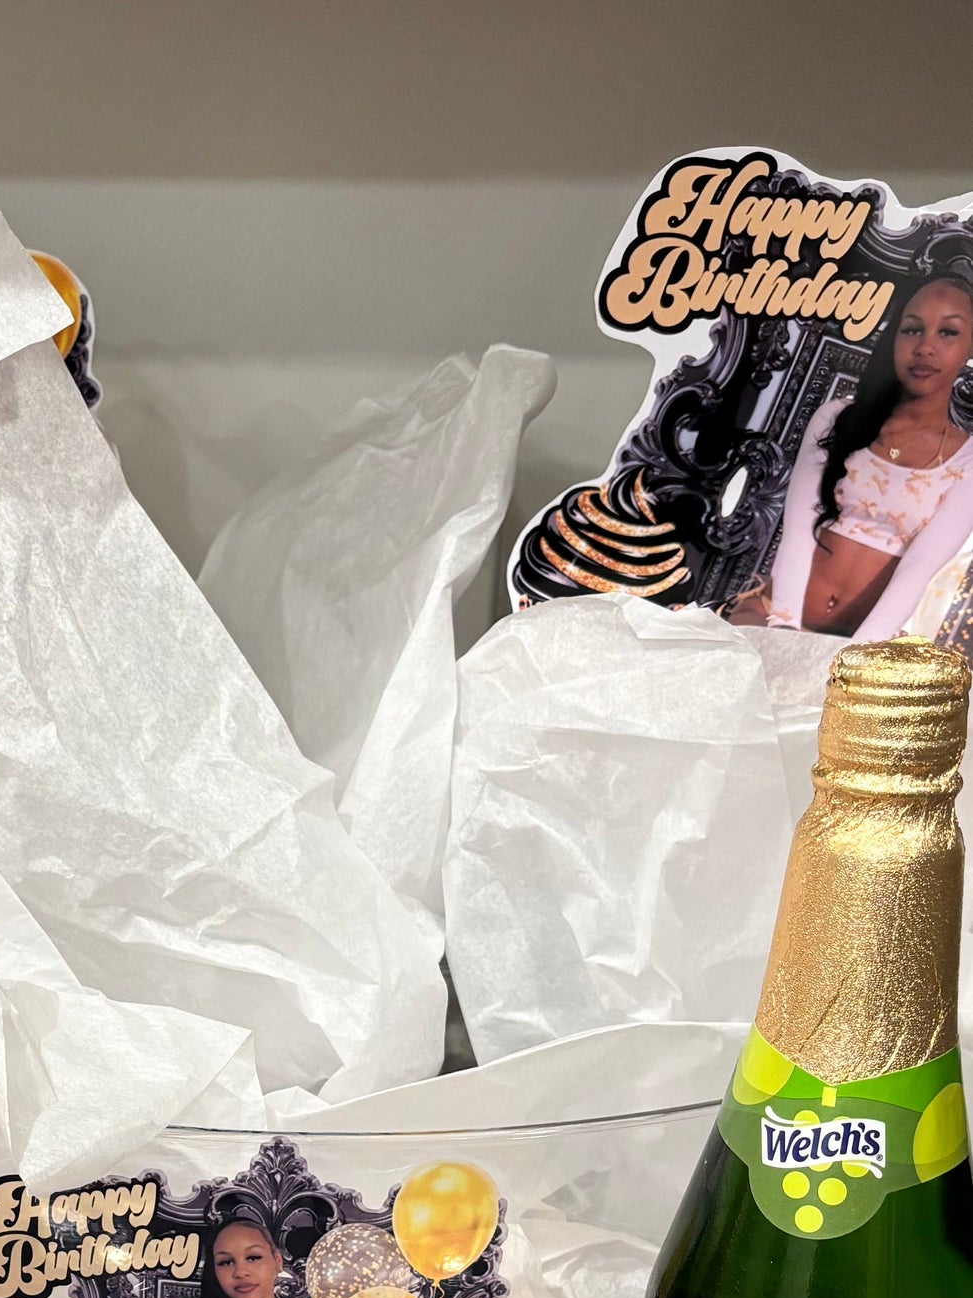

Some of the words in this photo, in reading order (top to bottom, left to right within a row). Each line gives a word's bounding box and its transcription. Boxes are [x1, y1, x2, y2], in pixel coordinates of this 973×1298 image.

[644, 160, 870, 260] Happy
[606, 239, 894, 341] Birthday
[764, 1122, 881, 1163] Welch's
